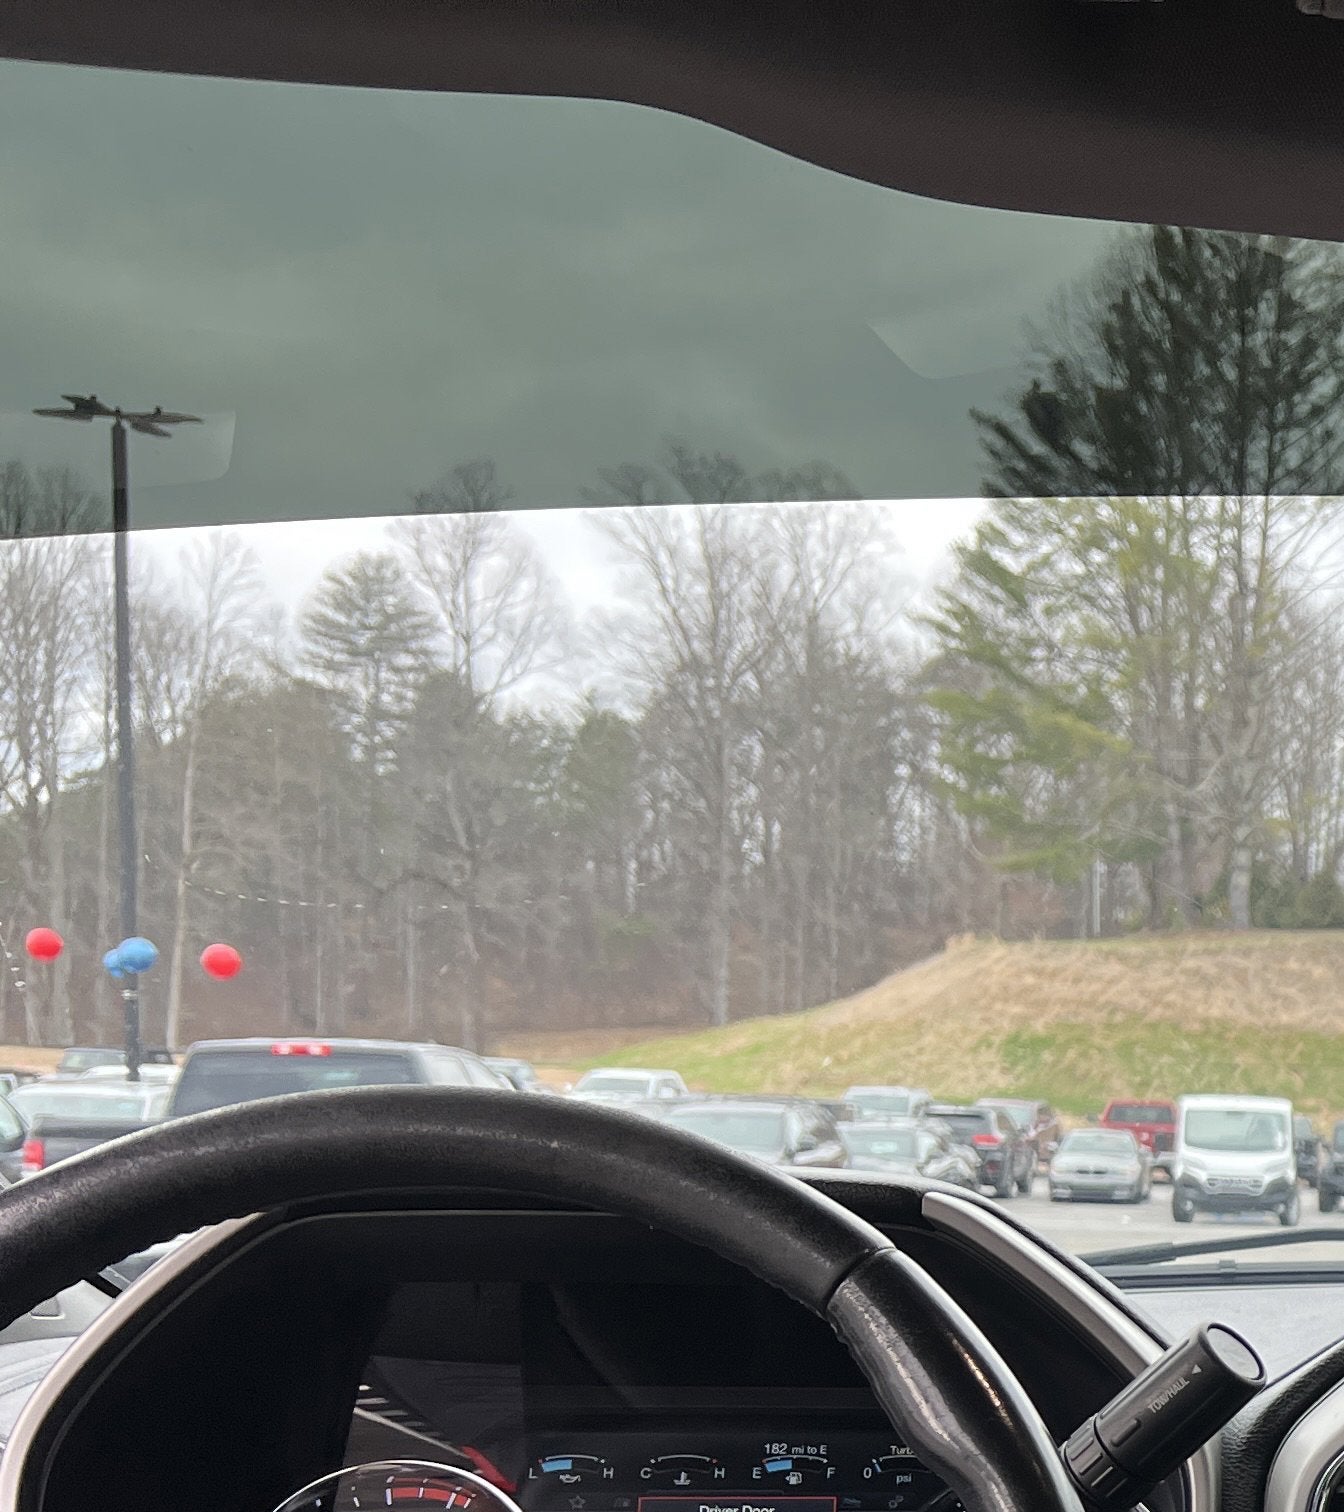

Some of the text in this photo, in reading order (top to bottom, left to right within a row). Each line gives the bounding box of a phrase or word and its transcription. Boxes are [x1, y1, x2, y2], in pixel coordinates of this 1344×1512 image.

[1148, 1376, 1190, 1414] TOW/HAUL
[764, 1443, 827, 1455] 182 mi to E
[890, 1445, 914, 1456] Turb
[528, 1467, 538, 1479] L
[603, 1467, 614, 1479] H
[714, 1467, 725, 1479] H
[752, 1467, 762, 1479] E
[827, 1467, 836, 1479] F
[896, 1472, 912, 1486] psi
